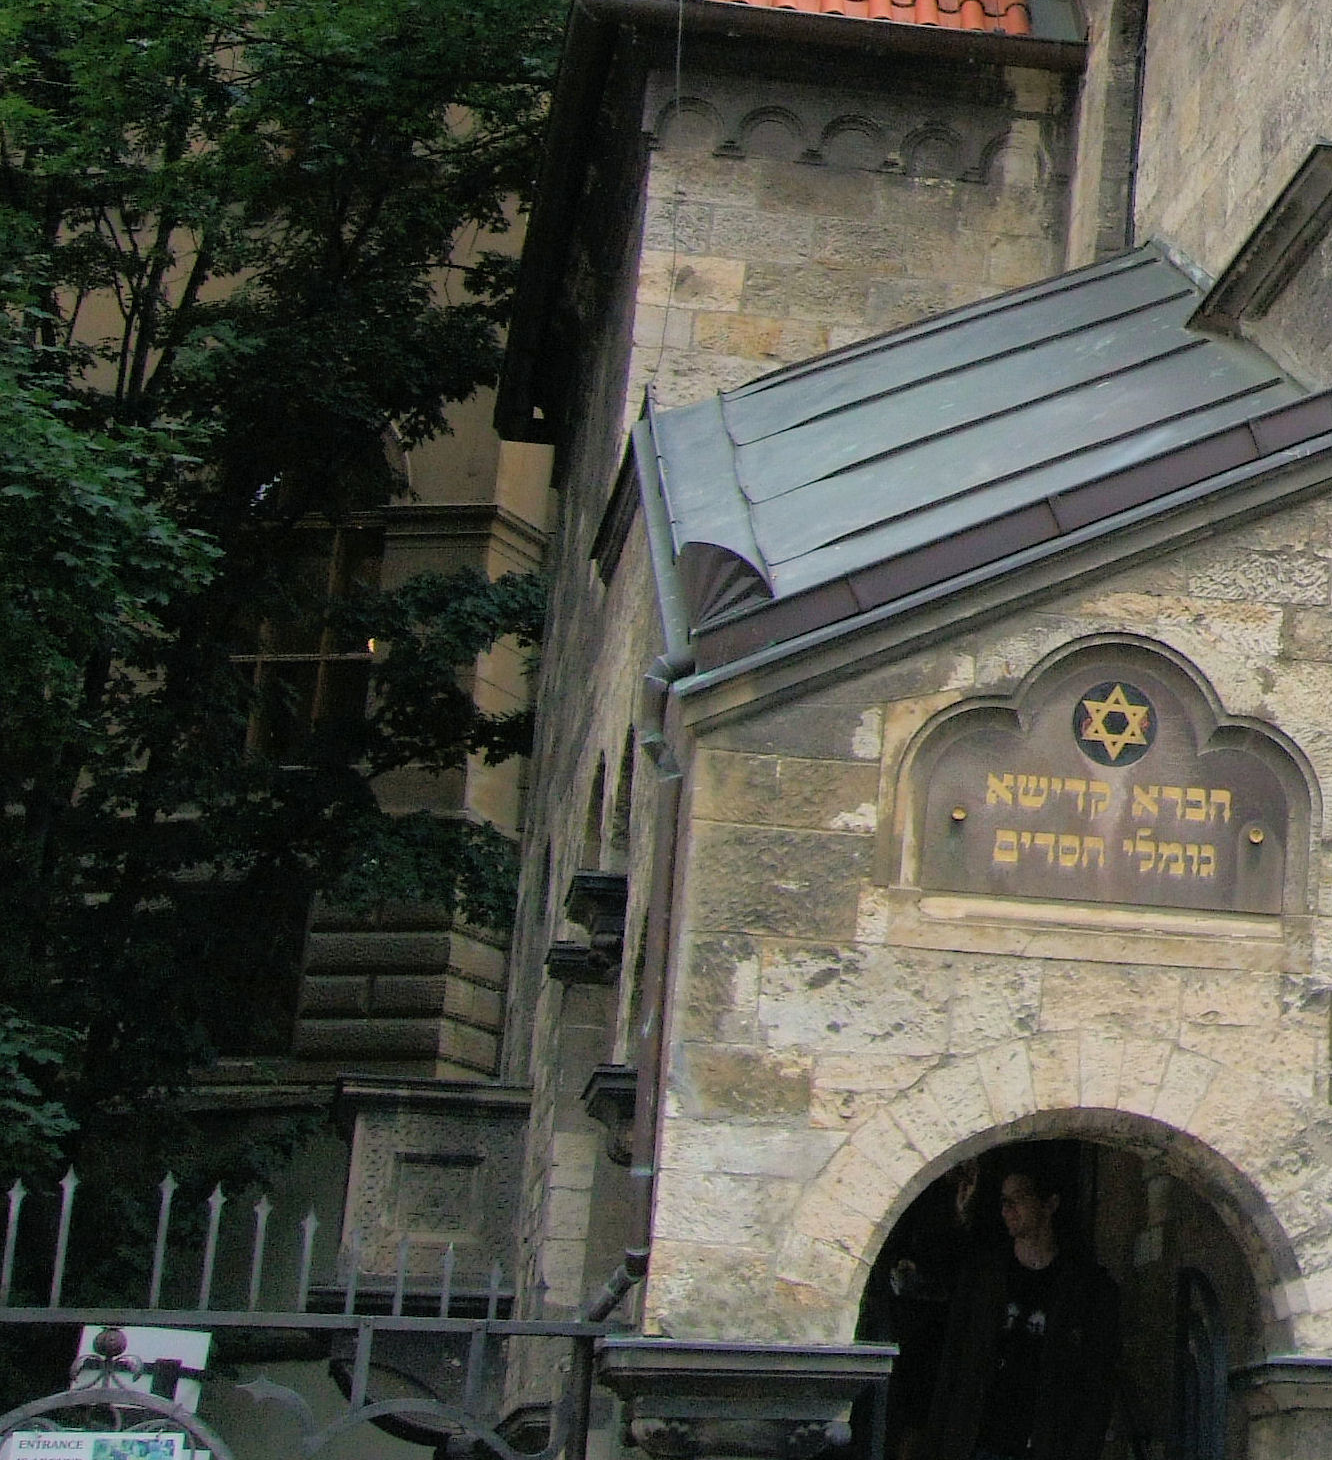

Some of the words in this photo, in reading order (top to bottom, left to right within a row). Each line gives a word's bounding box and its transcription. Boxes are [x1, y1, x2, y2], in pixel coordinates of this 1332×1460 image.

[985, 771, 1112, 821] קדישא
[1131, 784, 1232, 823] חברא
[992, 828, 1105, 868] חסדים
[1122, 827, 1217, 877] גומלי
[18, 1439, 84, 1450] ENTRANCE
